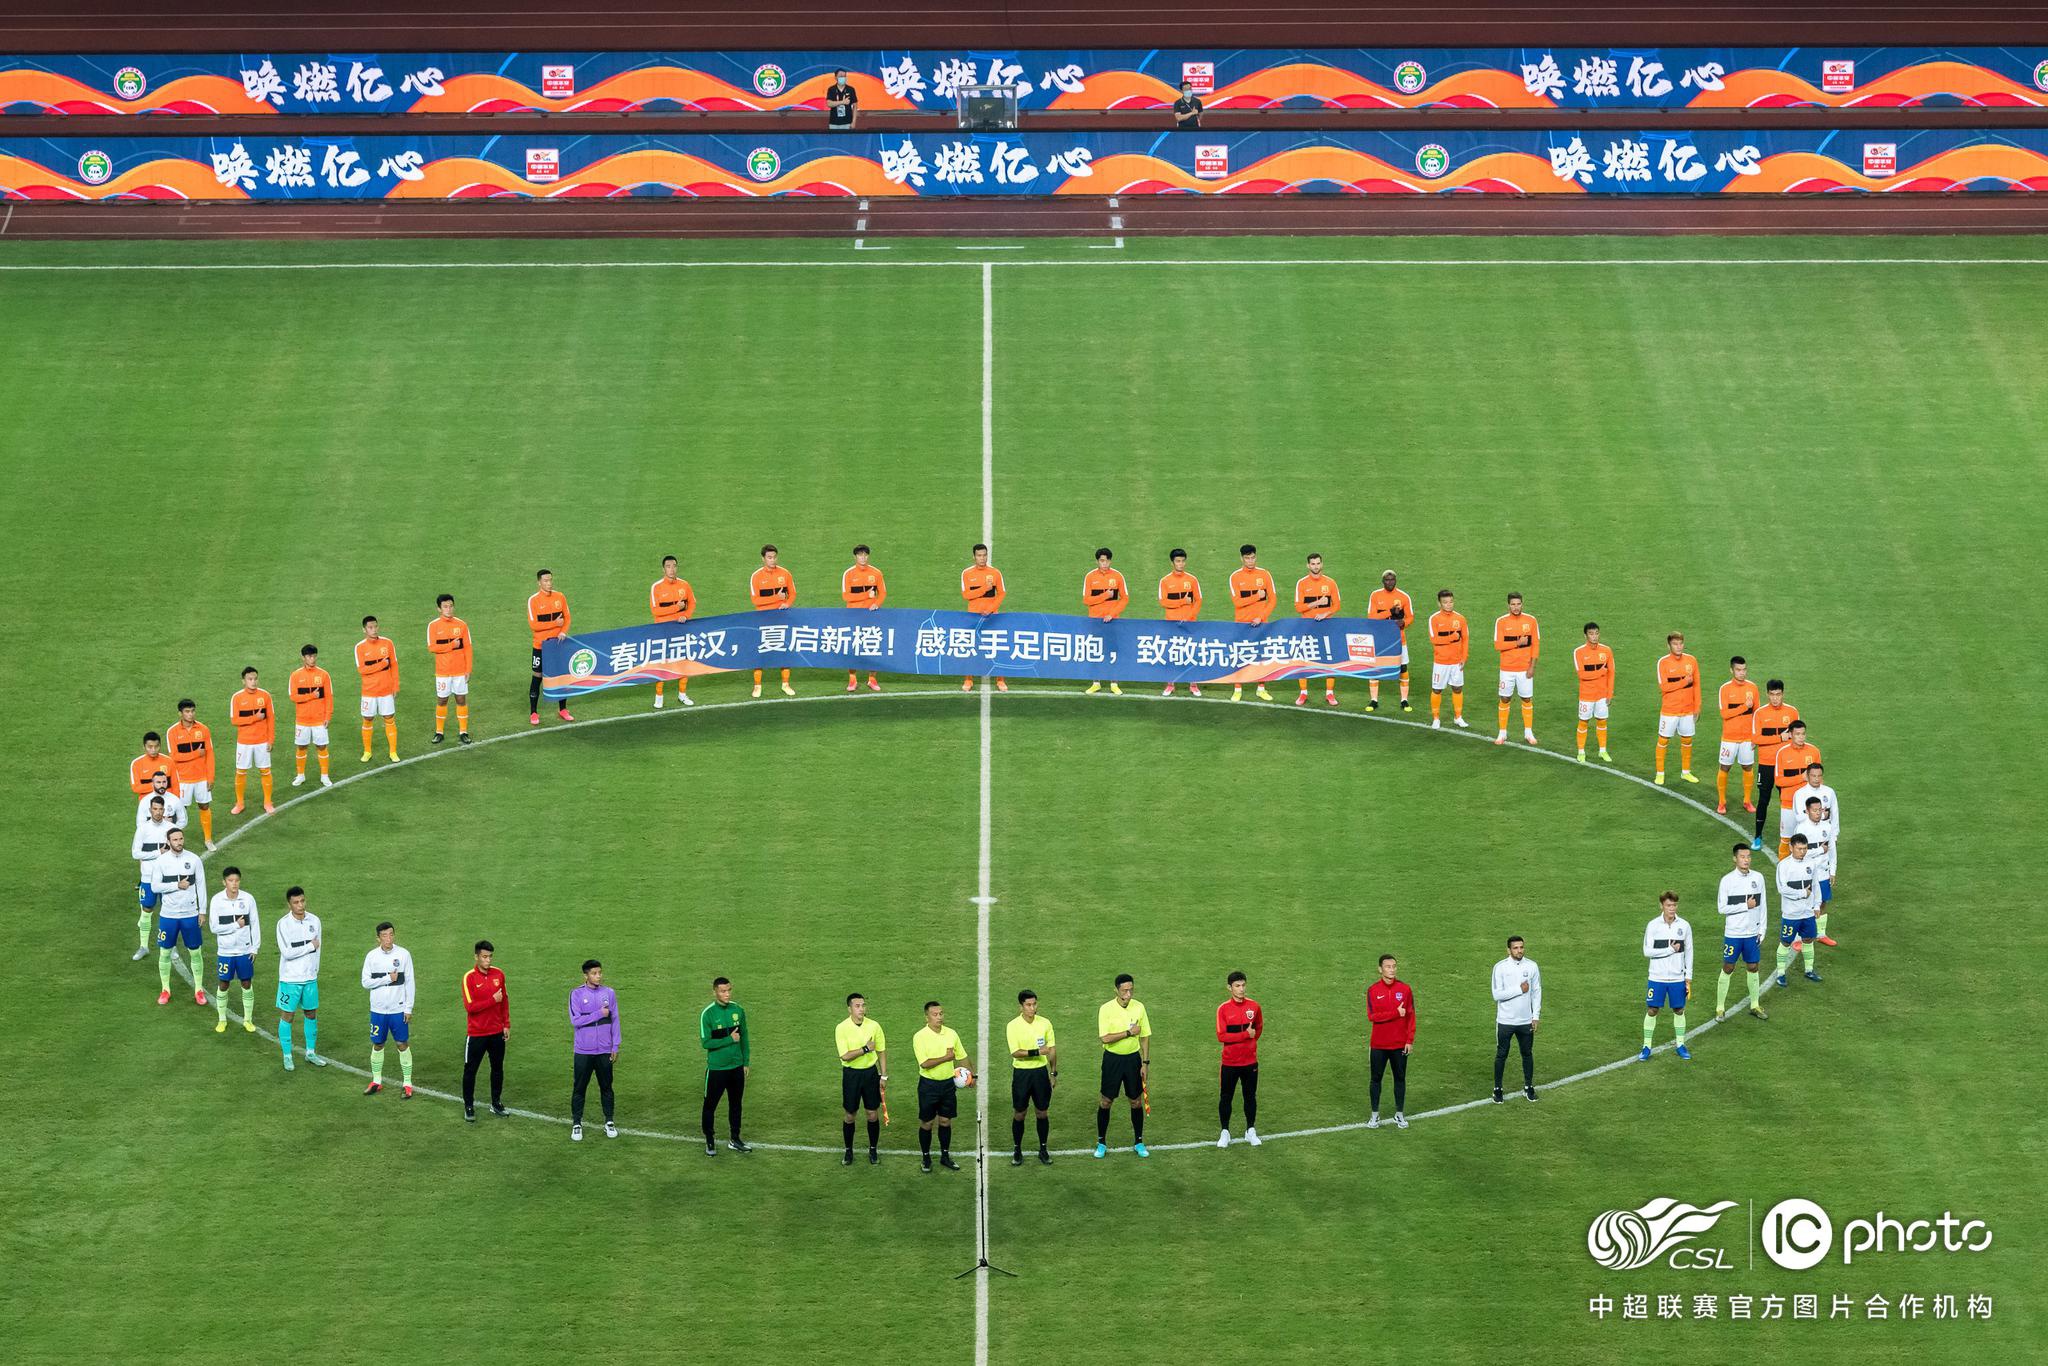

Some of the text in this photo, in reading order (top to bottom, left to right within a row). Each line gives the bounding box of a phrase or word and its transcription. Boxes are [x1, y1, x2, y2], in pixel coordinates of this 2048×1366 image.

[240, 59, 446, 105] 唤燃亿心
[880, 56, 1086, 102] 唤燃亿心
[1520, 54, 1726, 99] 唤燃亿心
[210, 143, 425, 190] 唤燃亿心
[879, 139, 1094, 187] 唤燃亿心
[1548, 137, 1762, 184] 唤燃亿心
[1723, 943, 1735, 956] 23
[1782, 924, 1794, 936] 33
[218, 963, 229, 975] 25
[279, 992, 291, 1005] 22
[1647, 988, 1654, 999] 6
